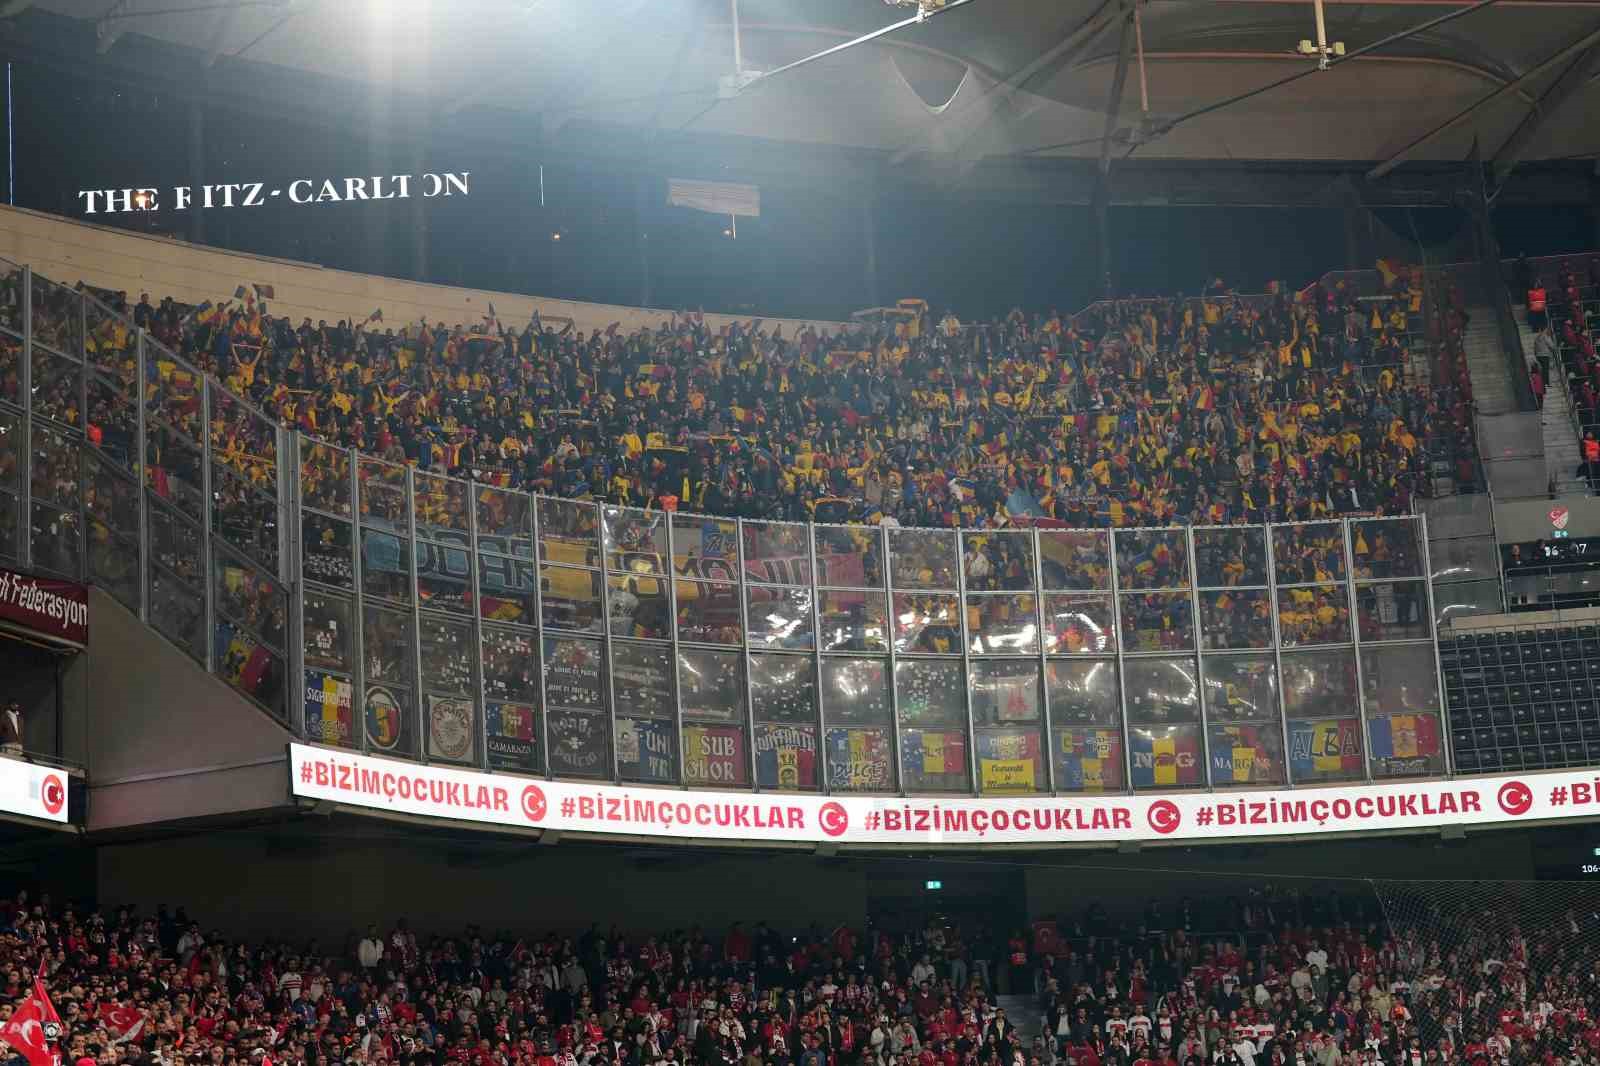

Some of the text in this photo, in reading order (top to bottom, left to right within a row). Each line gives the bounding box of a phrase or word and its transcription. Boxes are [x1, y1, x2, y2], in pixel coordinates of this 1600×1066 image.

[78, 188, 159, 214] THE
[701, 735, 736, 757] SUB
[301, 758, 508, 812] #BİZİMÇOCUKLAR
[560, 793, 804, 829] #BİZİMÇOCUKLAR
[864, 804, 1132, 836] #BİZİMÇOCUKLAR
[1196, 790, 1482, 826] #BİZİMÇOCUKLAR
